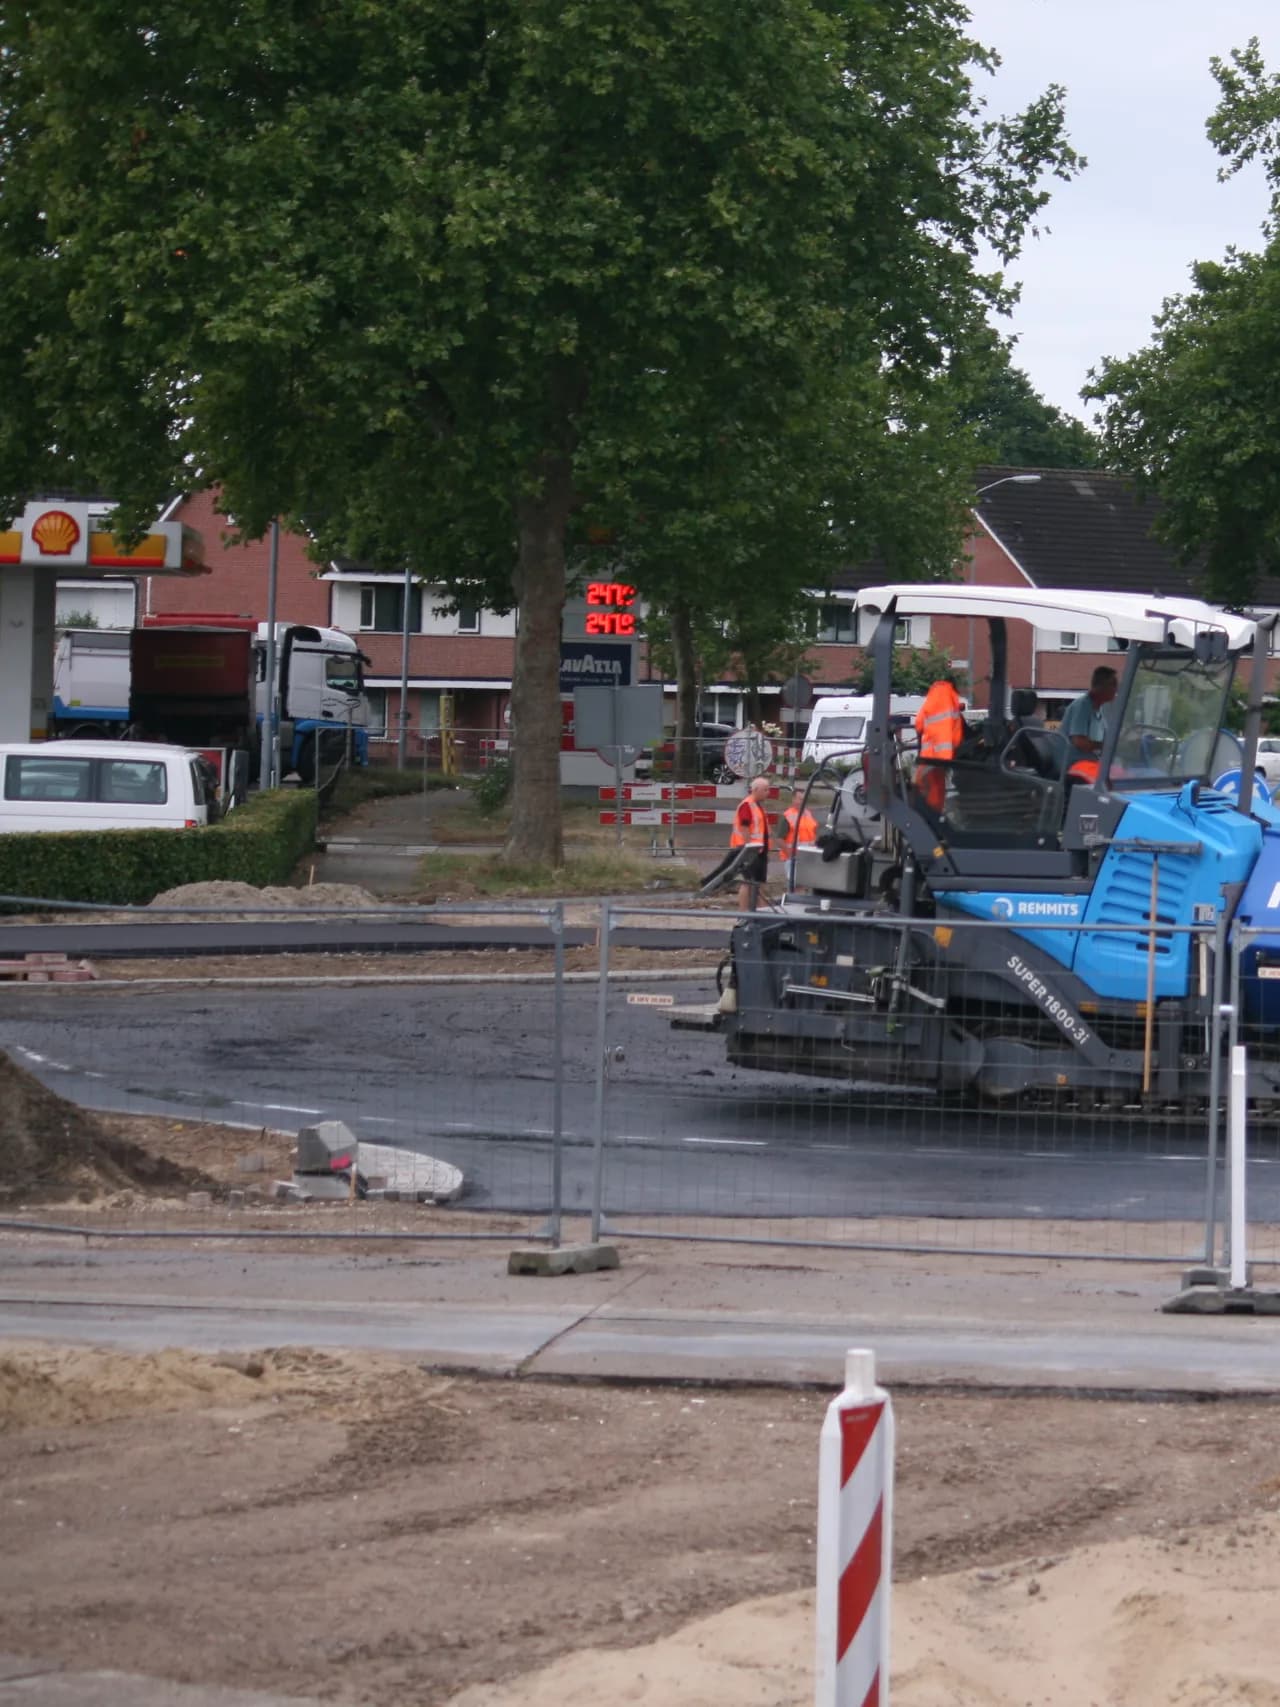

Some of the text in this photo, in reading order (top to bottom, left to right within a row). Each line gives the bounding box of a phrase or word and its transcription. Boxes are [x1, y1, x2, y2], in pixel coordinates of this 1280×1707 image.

[560, 654, 622, 674] AVAZZA
[1018, 902, 1079, 916] REMMITS
[1007, 955, 1091, 1045] SUPER 1800-3i
